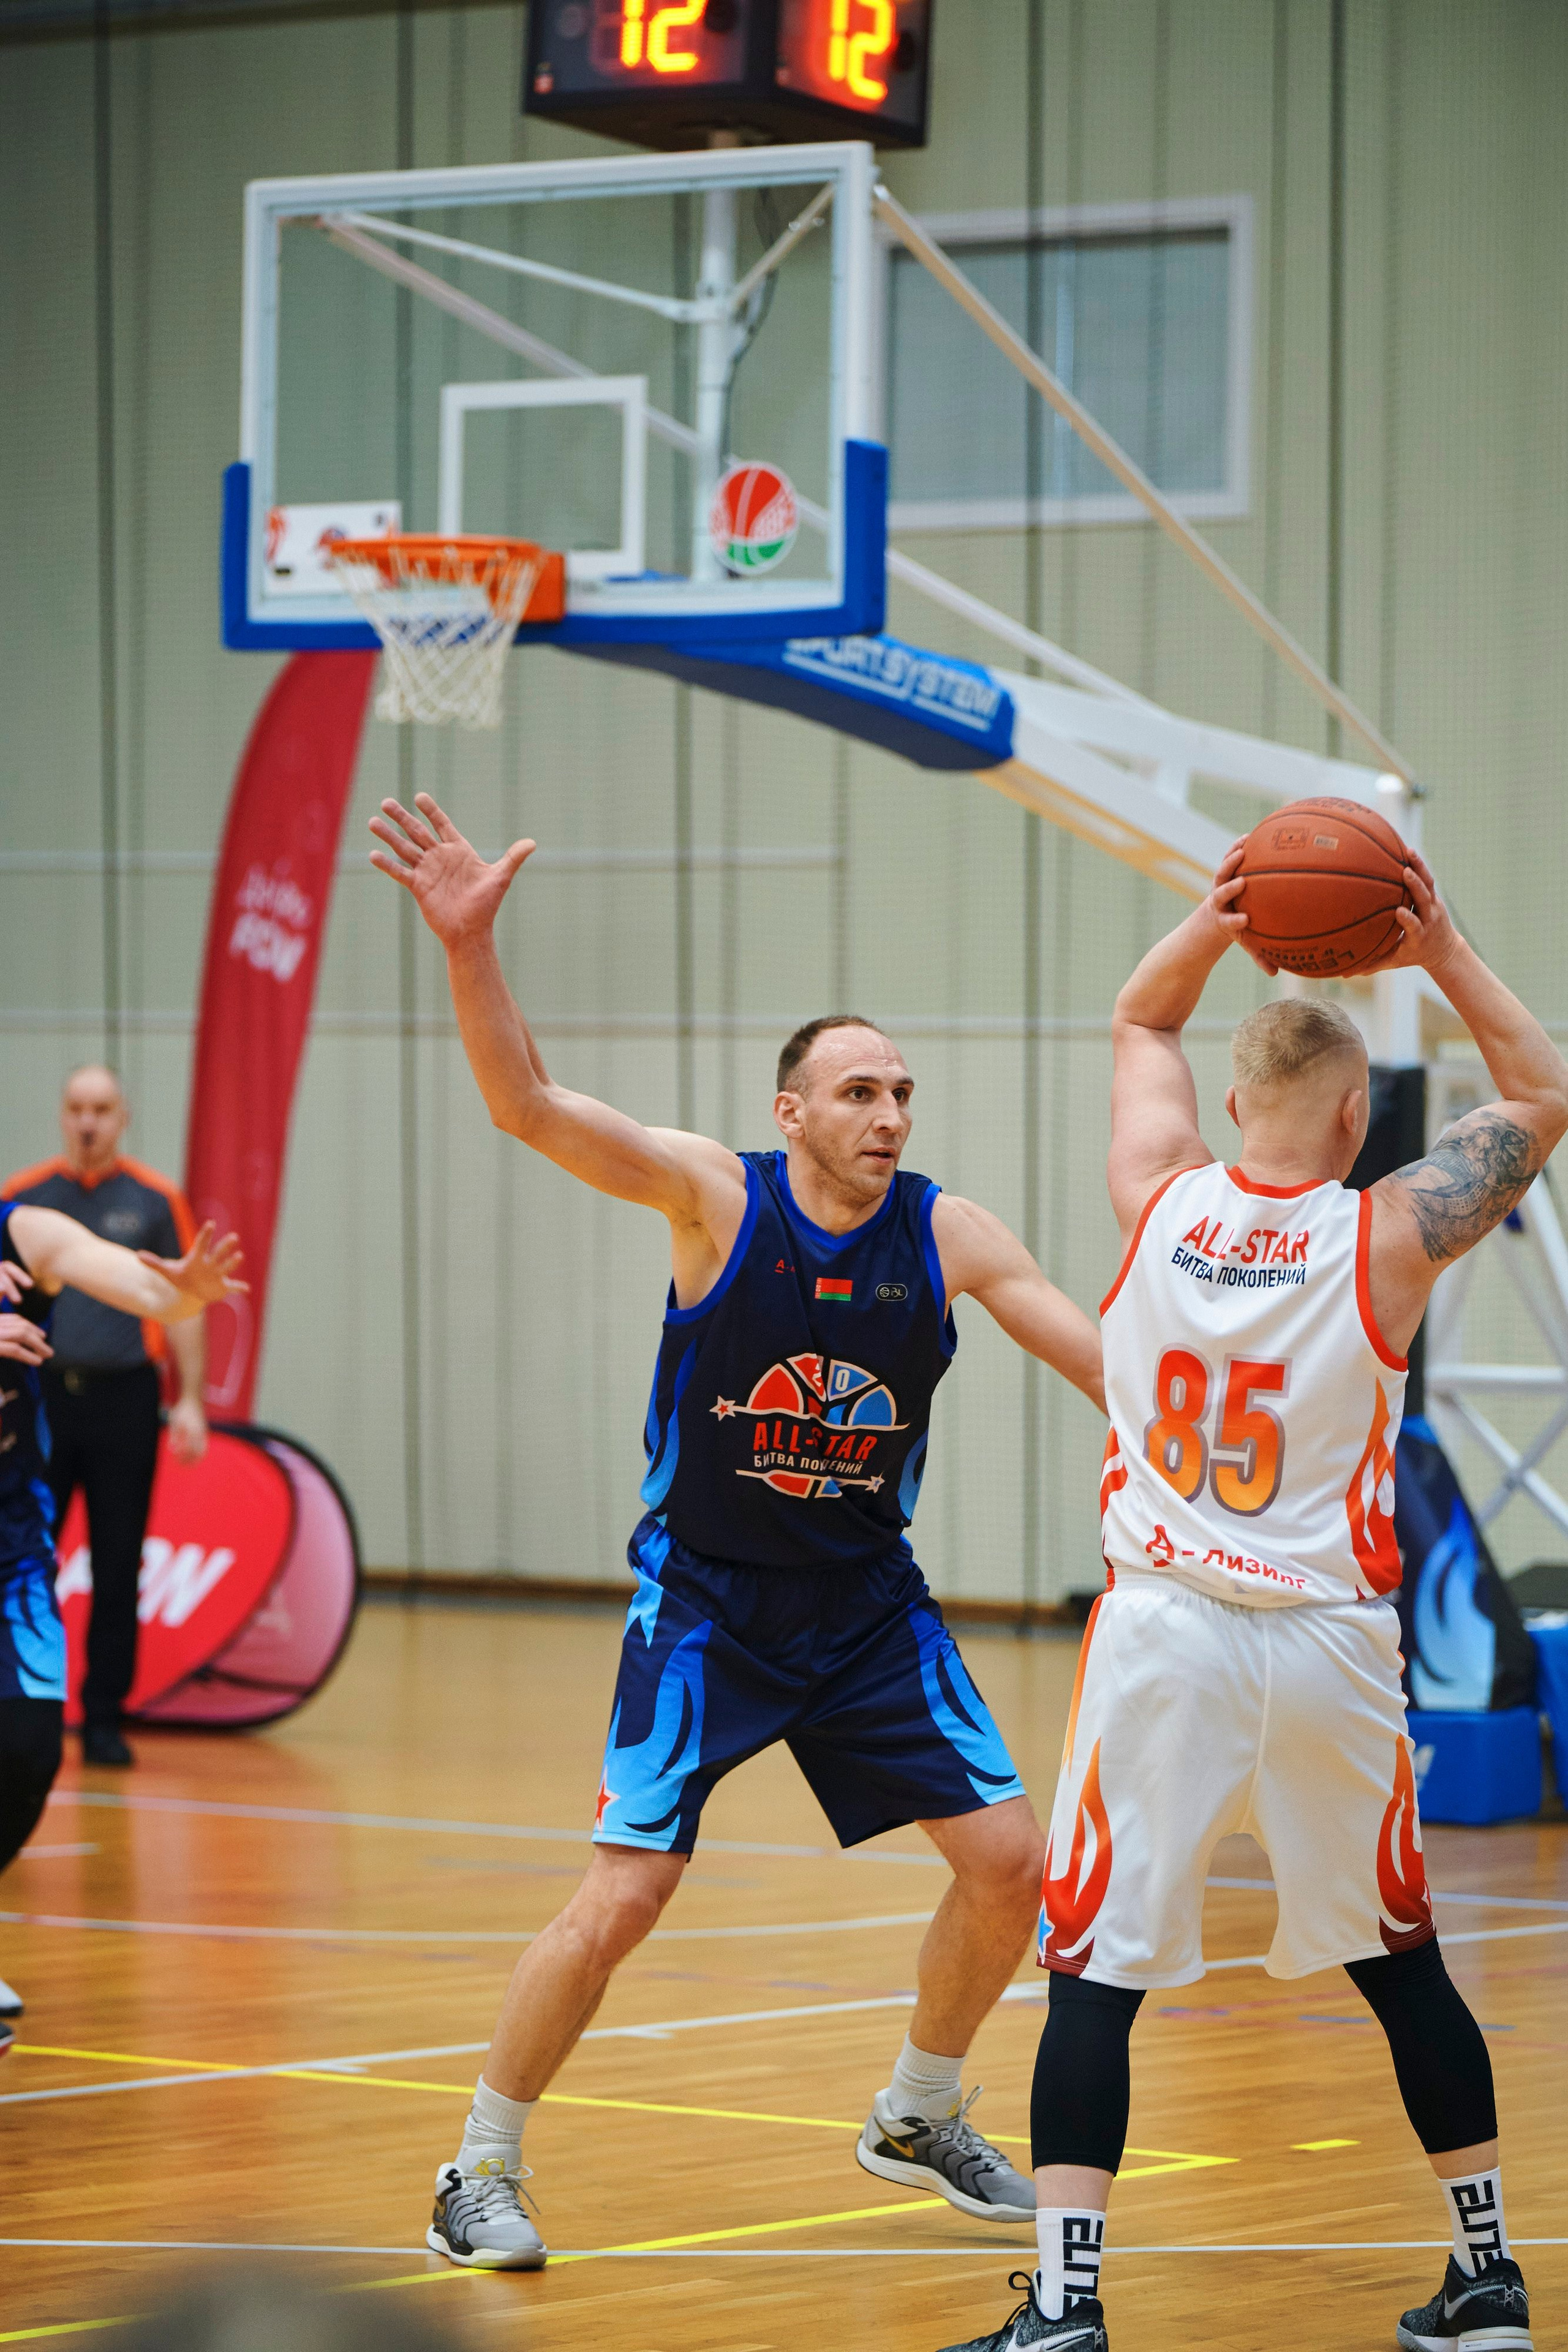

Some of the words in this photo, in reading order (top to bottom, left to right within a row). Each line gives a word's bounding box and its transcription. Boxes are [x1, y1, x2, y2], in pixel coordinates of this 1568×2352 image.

[620, 0, 707, 72] 12
[828, 0, 895, 101] 12
[1170, 1246, 1215, 1283] БИТВА
[1216, 1262, 1306, 1288] ПОКОЛЕНИЙ
[1182, 1215, 1310, 1264] ALL-STAR
[753, 1452, 794, 1468] БИТВА
[1142, 1342, 1292, 1518] 85
